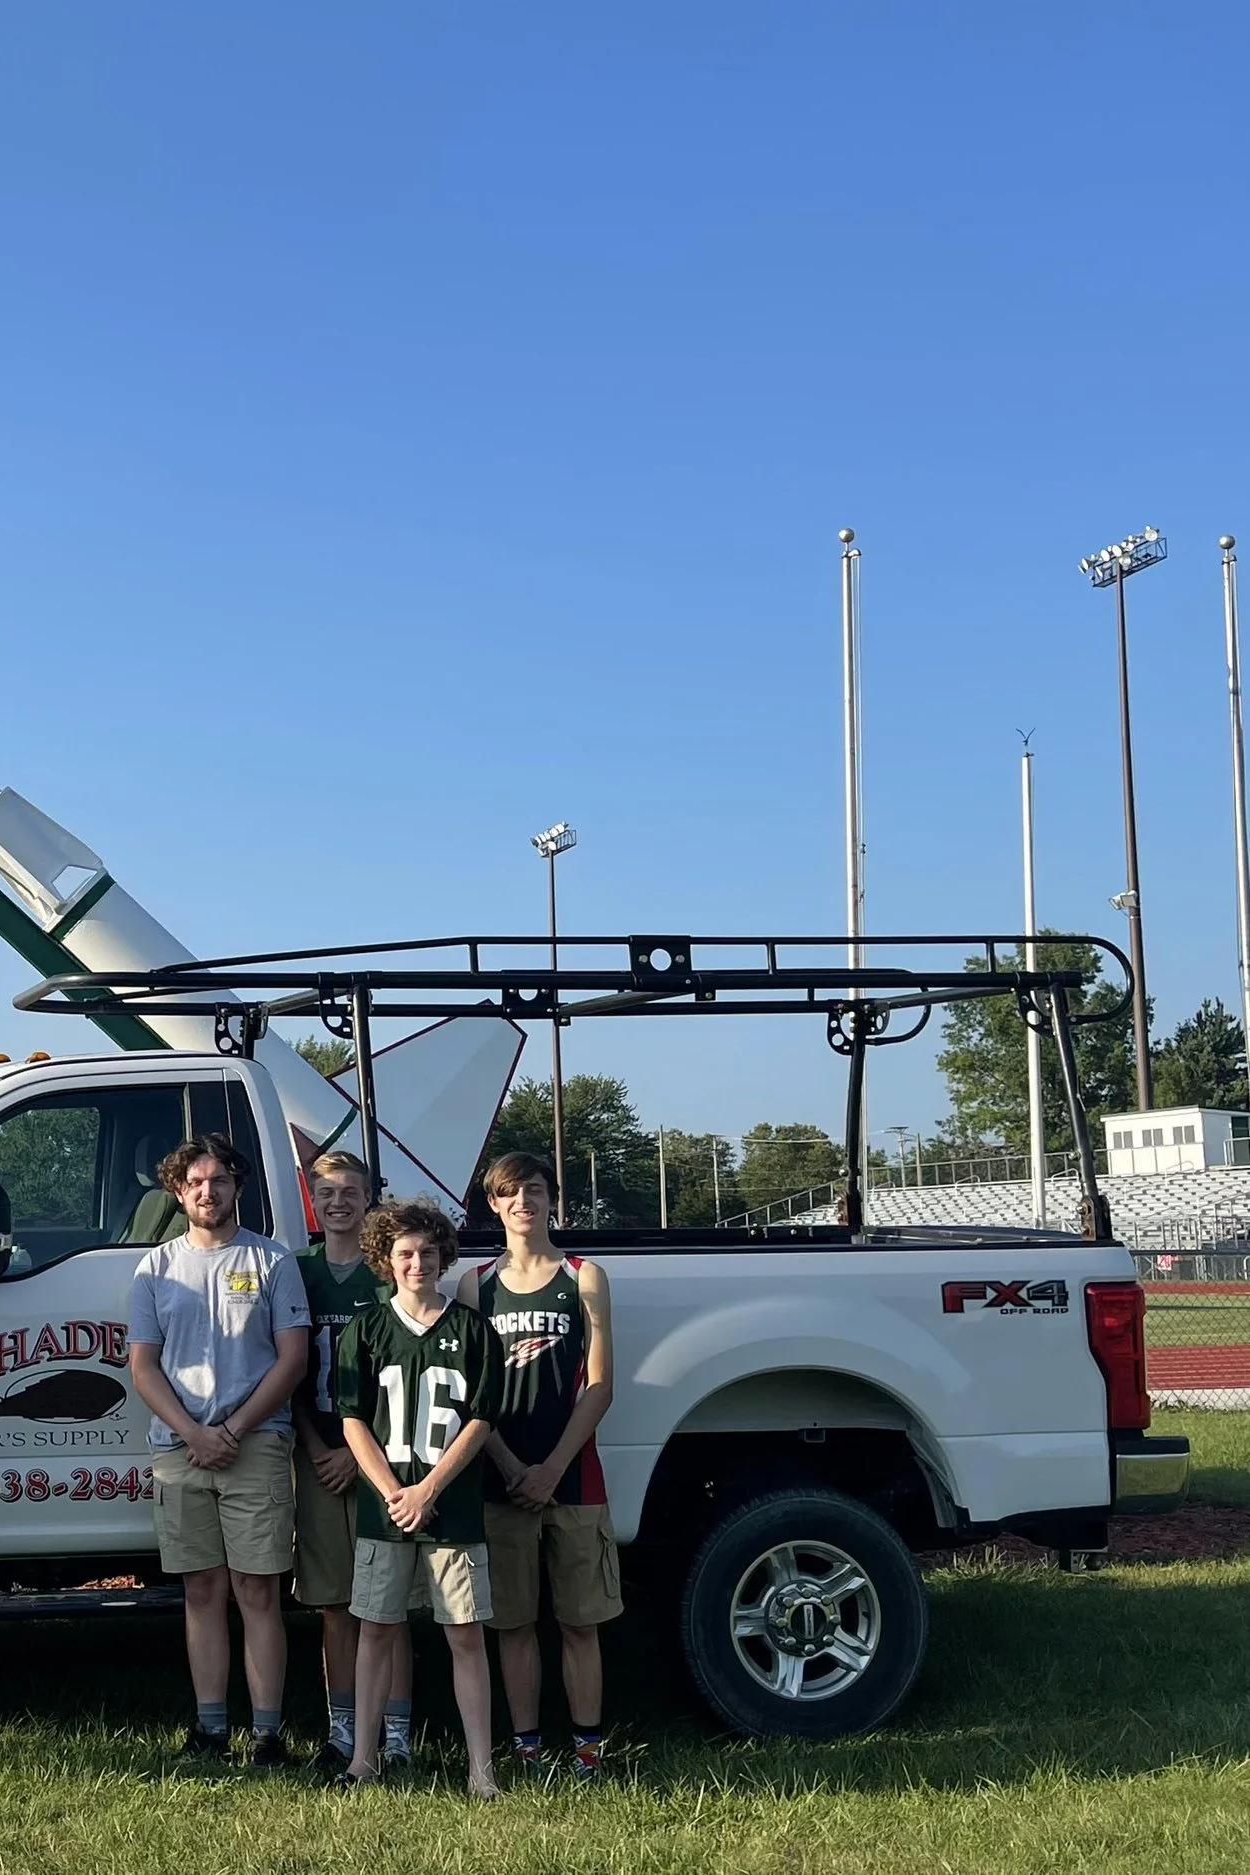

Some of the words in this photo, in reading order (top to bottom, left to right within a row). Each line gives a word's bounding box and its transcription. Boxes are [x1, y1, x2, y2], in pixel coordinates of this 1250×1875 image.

[941, 1279, 1069, 1314] FX4
[378, 1364, 467, 1466] 16
[33, 1429, 130, 1447] SUPPLY
